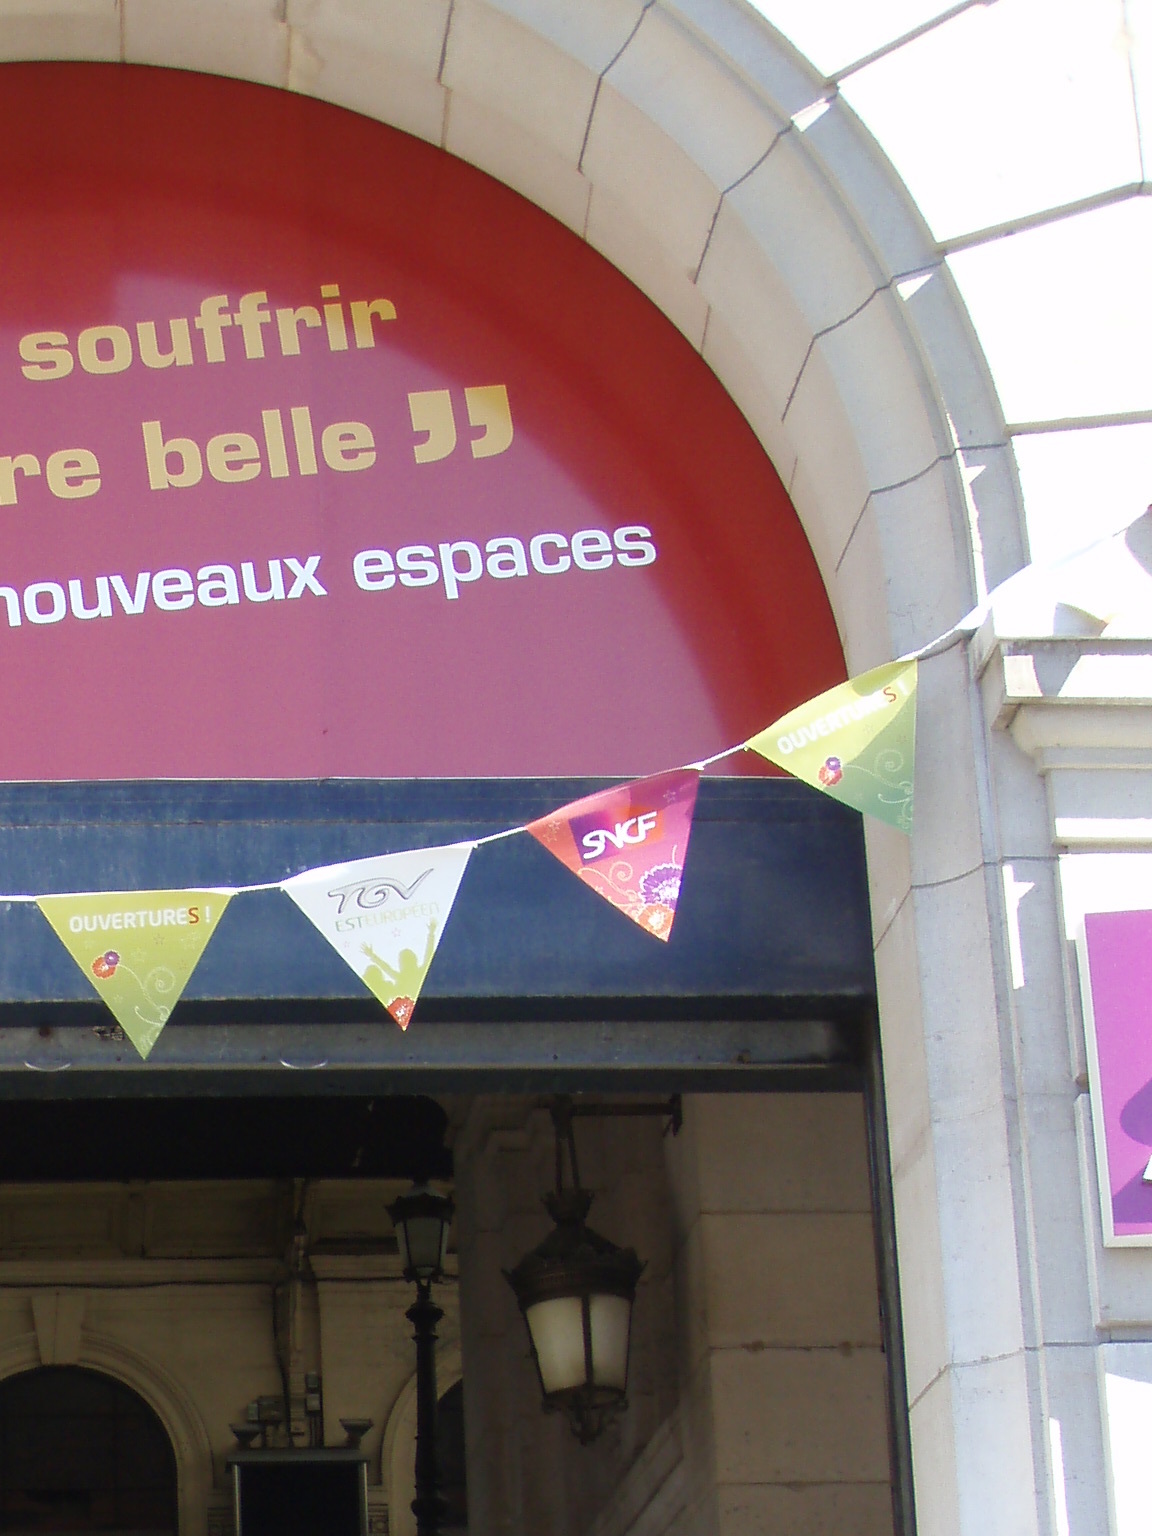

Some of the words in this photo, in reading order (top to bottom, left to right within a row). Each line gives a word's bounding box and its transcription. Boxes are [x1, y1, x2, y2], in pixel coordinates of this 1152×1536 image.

[17, 283, 398, 382] souffrir
[140, 404, 378, 492] belle
[351, 524, 658, 602] espaces
[582, 810, 659, 861] SNCF
[68, 906, 201, 934] OUVERTURES
[326, 867, 436, 915] TGV
